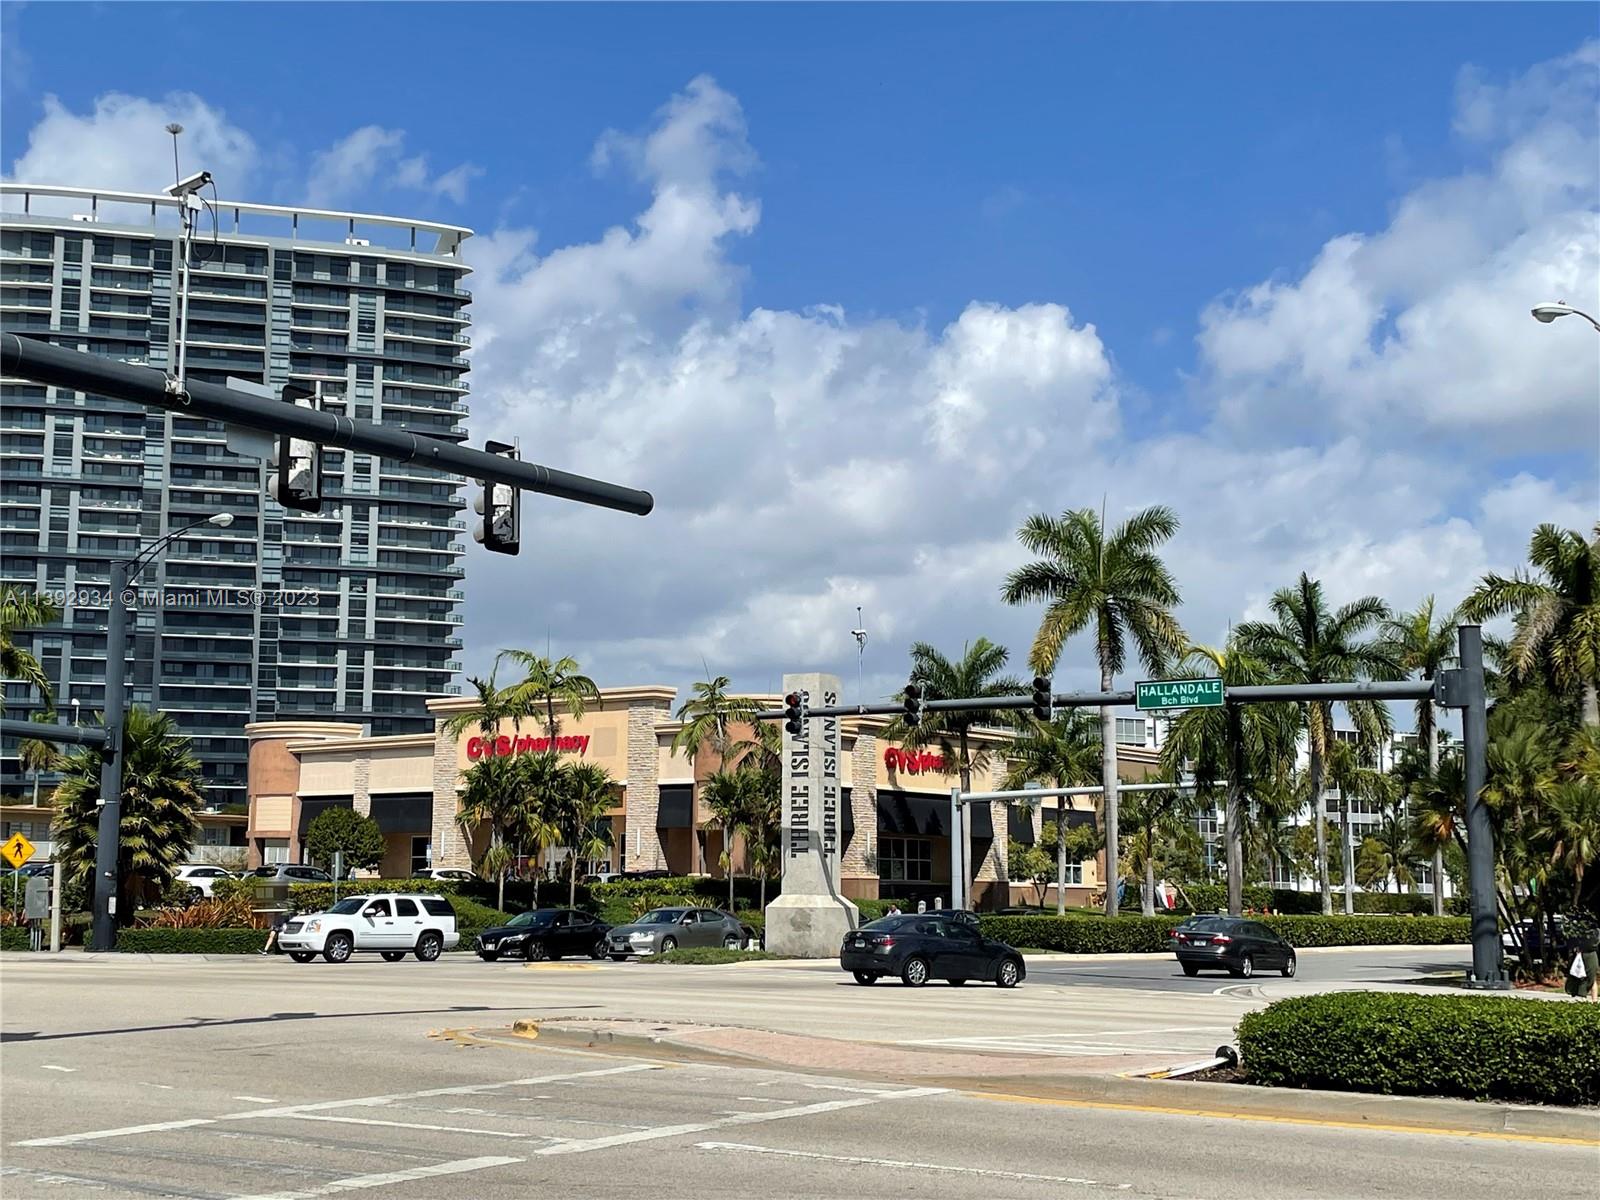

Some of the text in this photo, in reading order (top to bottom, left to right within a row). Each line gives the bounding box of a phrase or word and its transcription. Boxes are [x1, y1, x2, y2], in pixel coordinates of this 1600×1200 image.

[1140, 683, 1219, 696] HALLANDALE
[1161, 695, 1199, 705] Bch Blvd
[824, 691, 835, 858] THREE ISLANS
[791, 786, 808, 858] THREE
